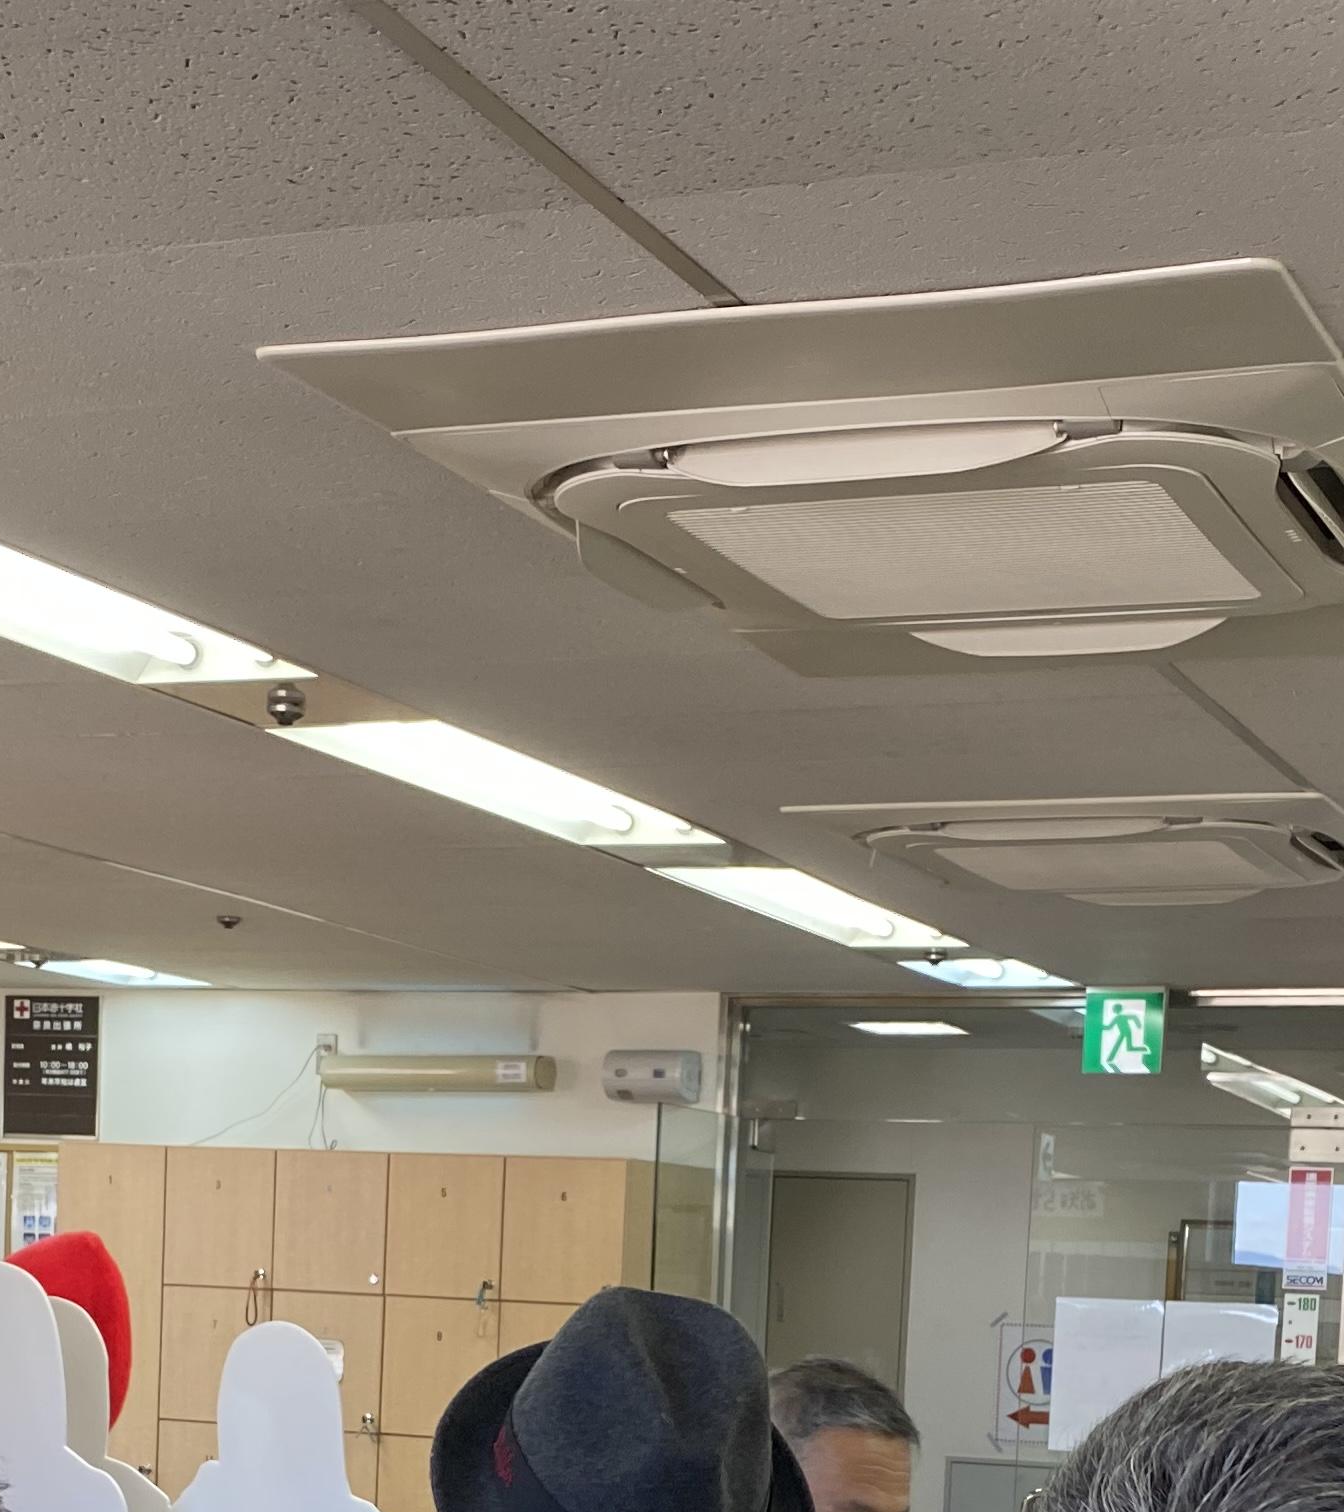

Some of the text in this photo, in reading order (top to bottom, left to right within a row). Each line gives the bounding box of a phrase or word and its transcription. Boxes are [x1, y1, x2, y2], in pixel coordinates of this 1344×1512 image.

[1286, 1274, 1324, 1286] SECOM
[1298, 1297, 1316, 1312] 180
[1295, 1335, 1313, 1349] 170
